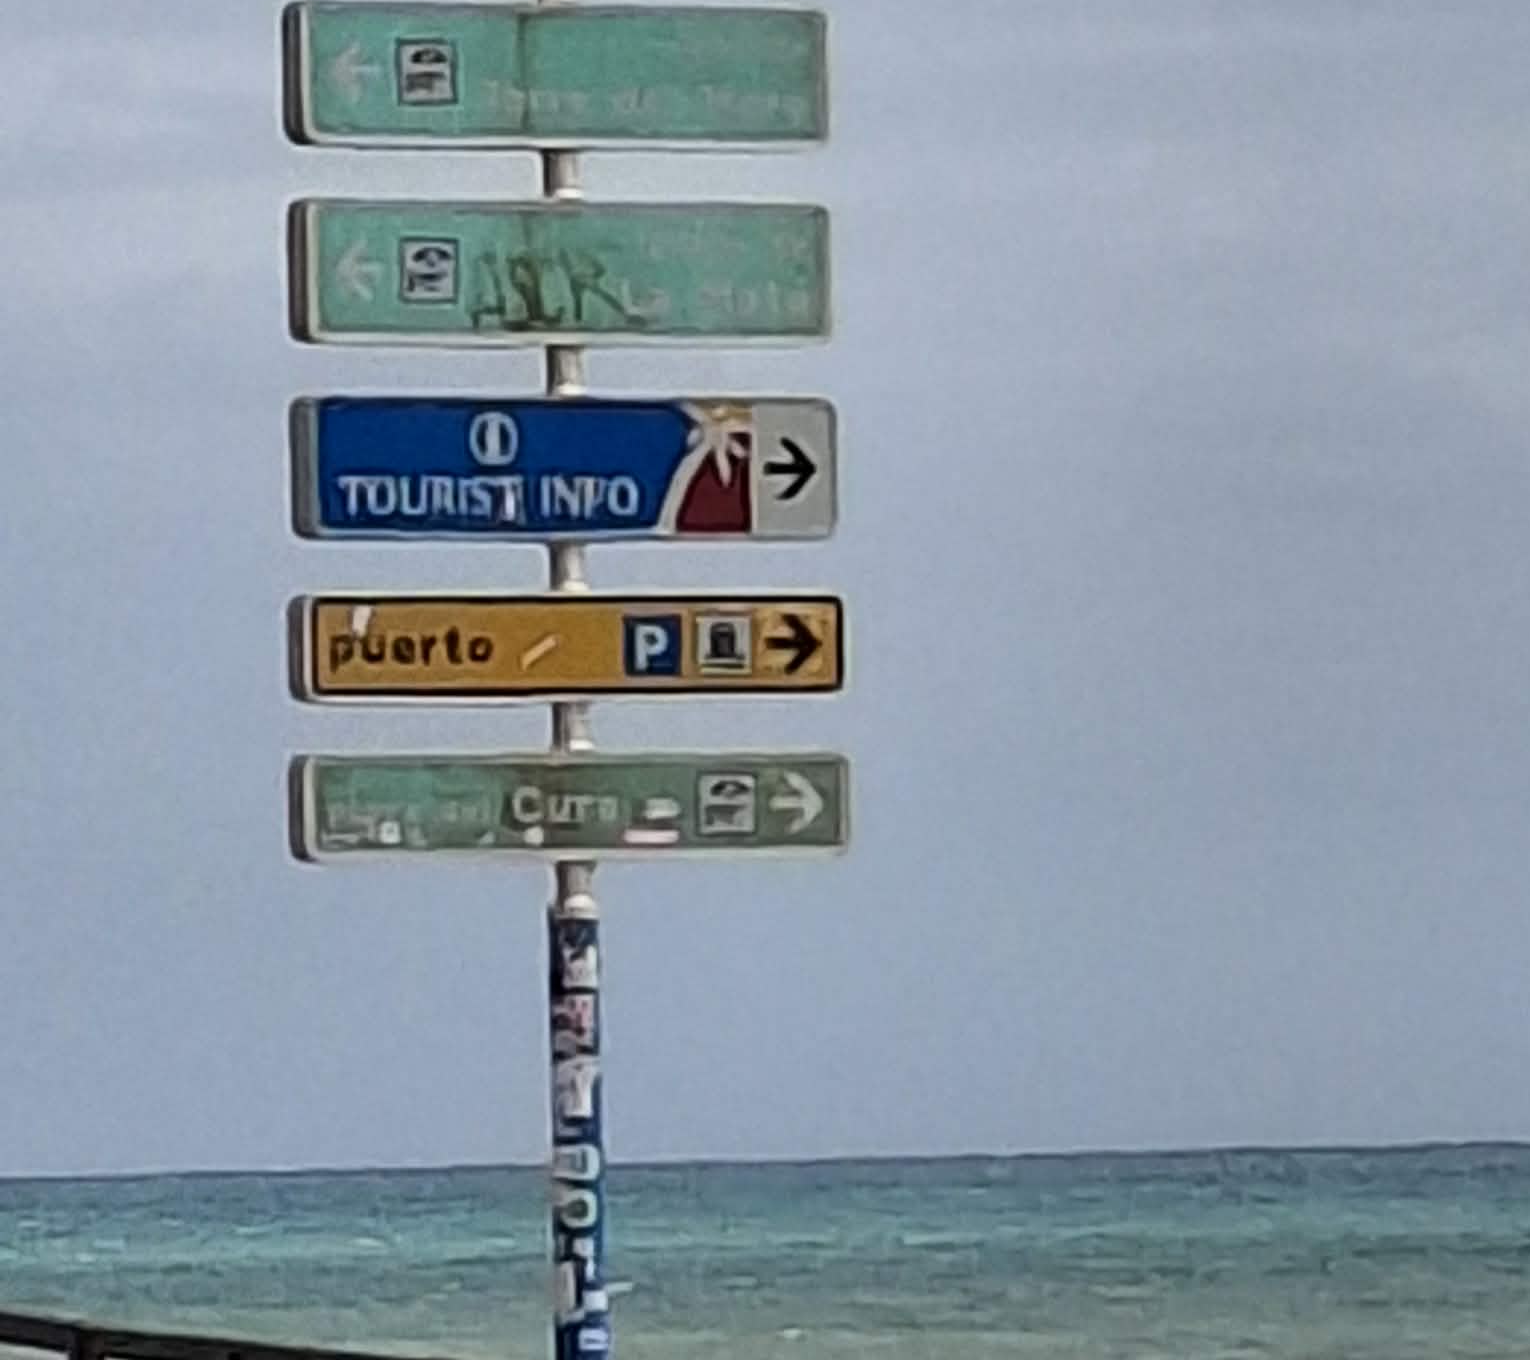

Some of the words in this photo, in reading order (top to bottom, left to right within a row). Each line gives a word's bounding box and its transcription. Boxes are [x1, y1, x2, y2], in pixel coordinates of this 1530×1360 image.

[339, 475, 522, 519] TOURIST
[329, 629, 493, 671] puerto
[635, 626, 669, 669] P
